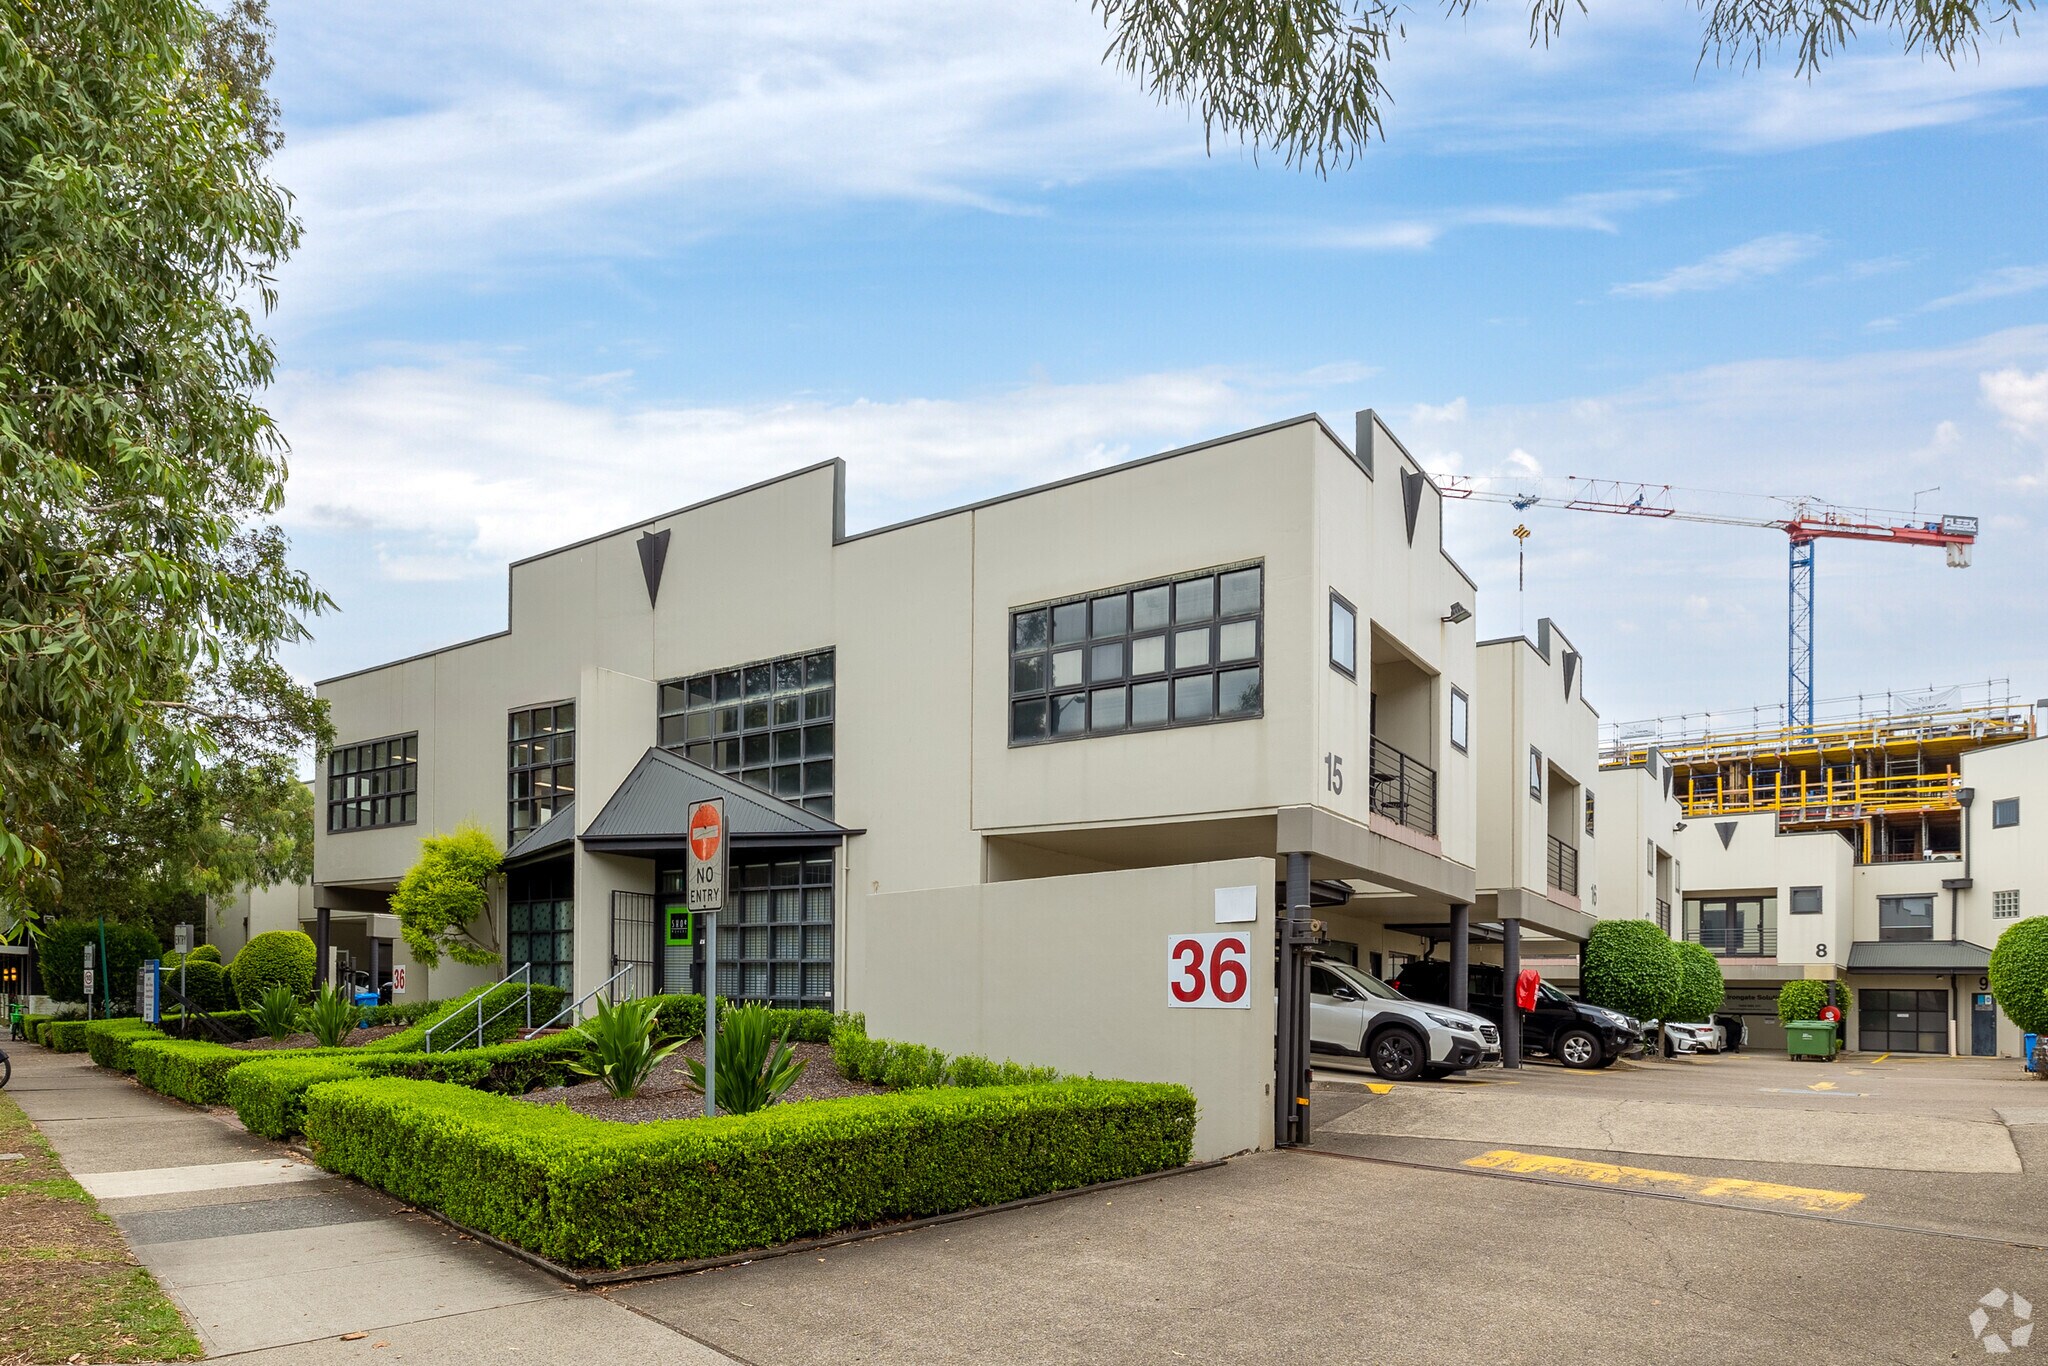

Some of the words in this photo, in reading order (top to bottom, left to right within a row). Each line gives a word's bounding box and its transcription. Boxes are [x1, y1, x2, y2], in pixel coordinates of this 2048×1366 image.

[1324, 752, 1343, 796] 15
[697, 866, 713, 884] NO
[691, 888, 719, 903] ENTRY
[1816, 943, 1828, 957] 8
[394, 968, 405, 989] 36
[1171, 938, 1248, 1003] 36
[1979, 976, 1989, 991] 9
